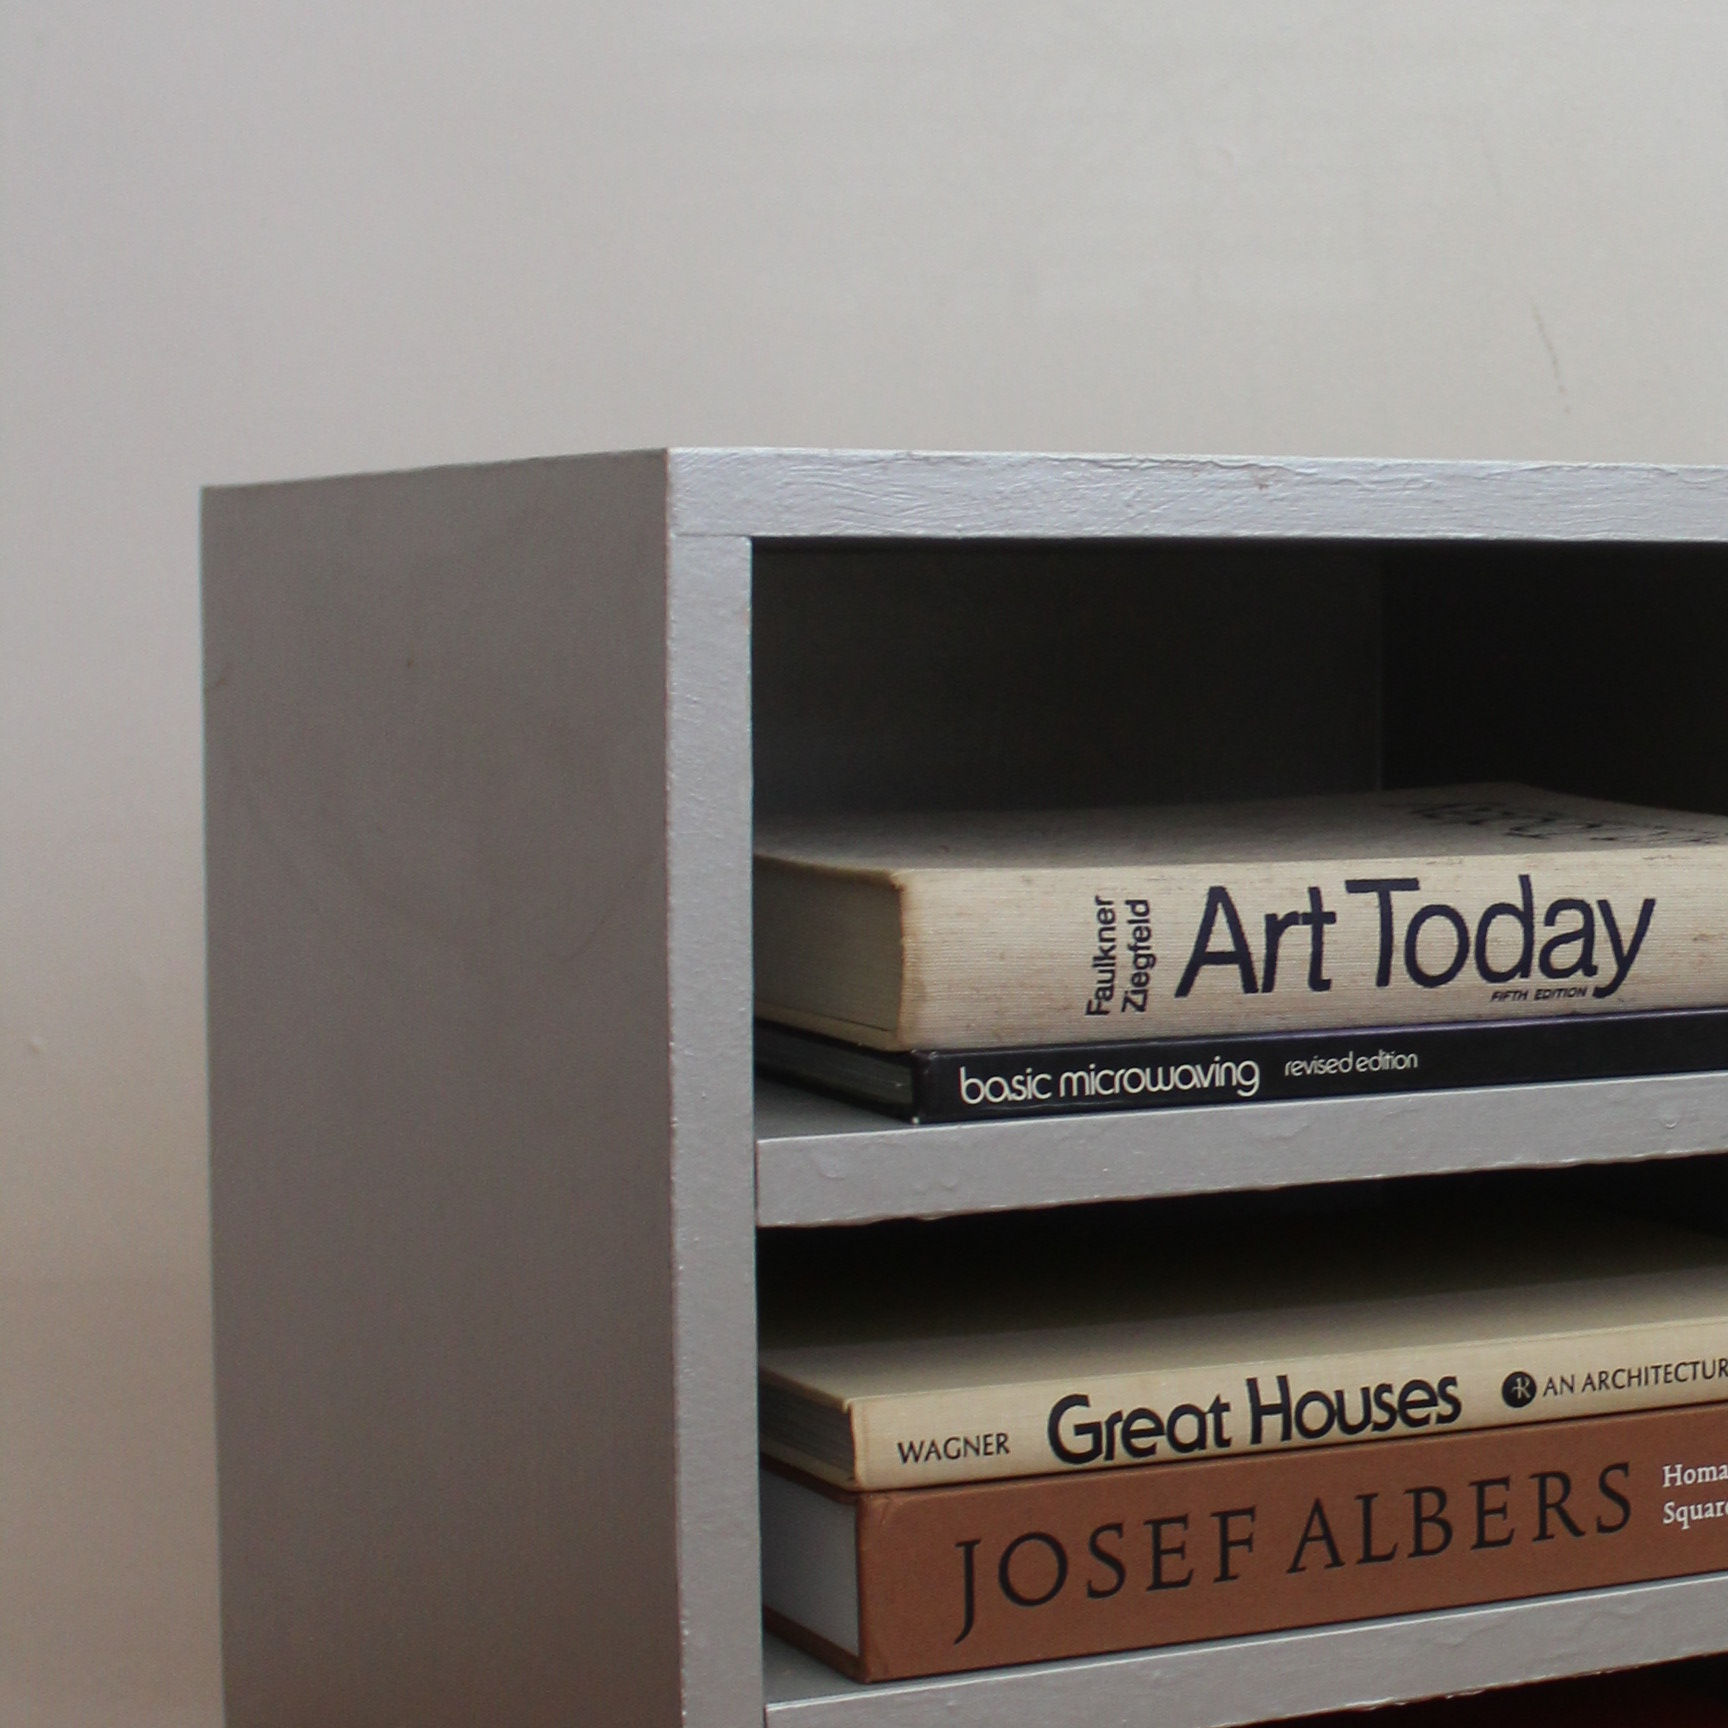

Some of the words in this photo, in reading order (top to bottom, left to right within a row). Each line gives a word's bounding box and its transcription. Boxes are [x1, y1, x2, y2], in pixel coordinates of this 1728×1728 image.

[1085, 895, 1116, 1015] Faulkner
[1121, 898, 1157, 1013] Ziegfeld
[1174, 885, 1337, 999] Art
[1344, 874, 1656, 1000] Today
[1490, 989, 1529, 1003] FIFTH
[1534, 986, 1588, 1002] EDITION
[960, 1067, 1052, 1106] basic
[1059, 1055, 1261, 1097] microwaving
[1284, 1051, 1355, 1078] revised
[1356, 1048, 1419, 1073] edition
[897, 1432, 1011, 1465] WAGNER
[1046, 1393, 1232, 1465] Great
[1245, 1374, 1463, 1446] Houses
[1542, 1375, 1576, 1398] AN
[953, 1506, 1258, 1646] JOSEF
[1286, 1461, 1633, 1575] ALBERS
